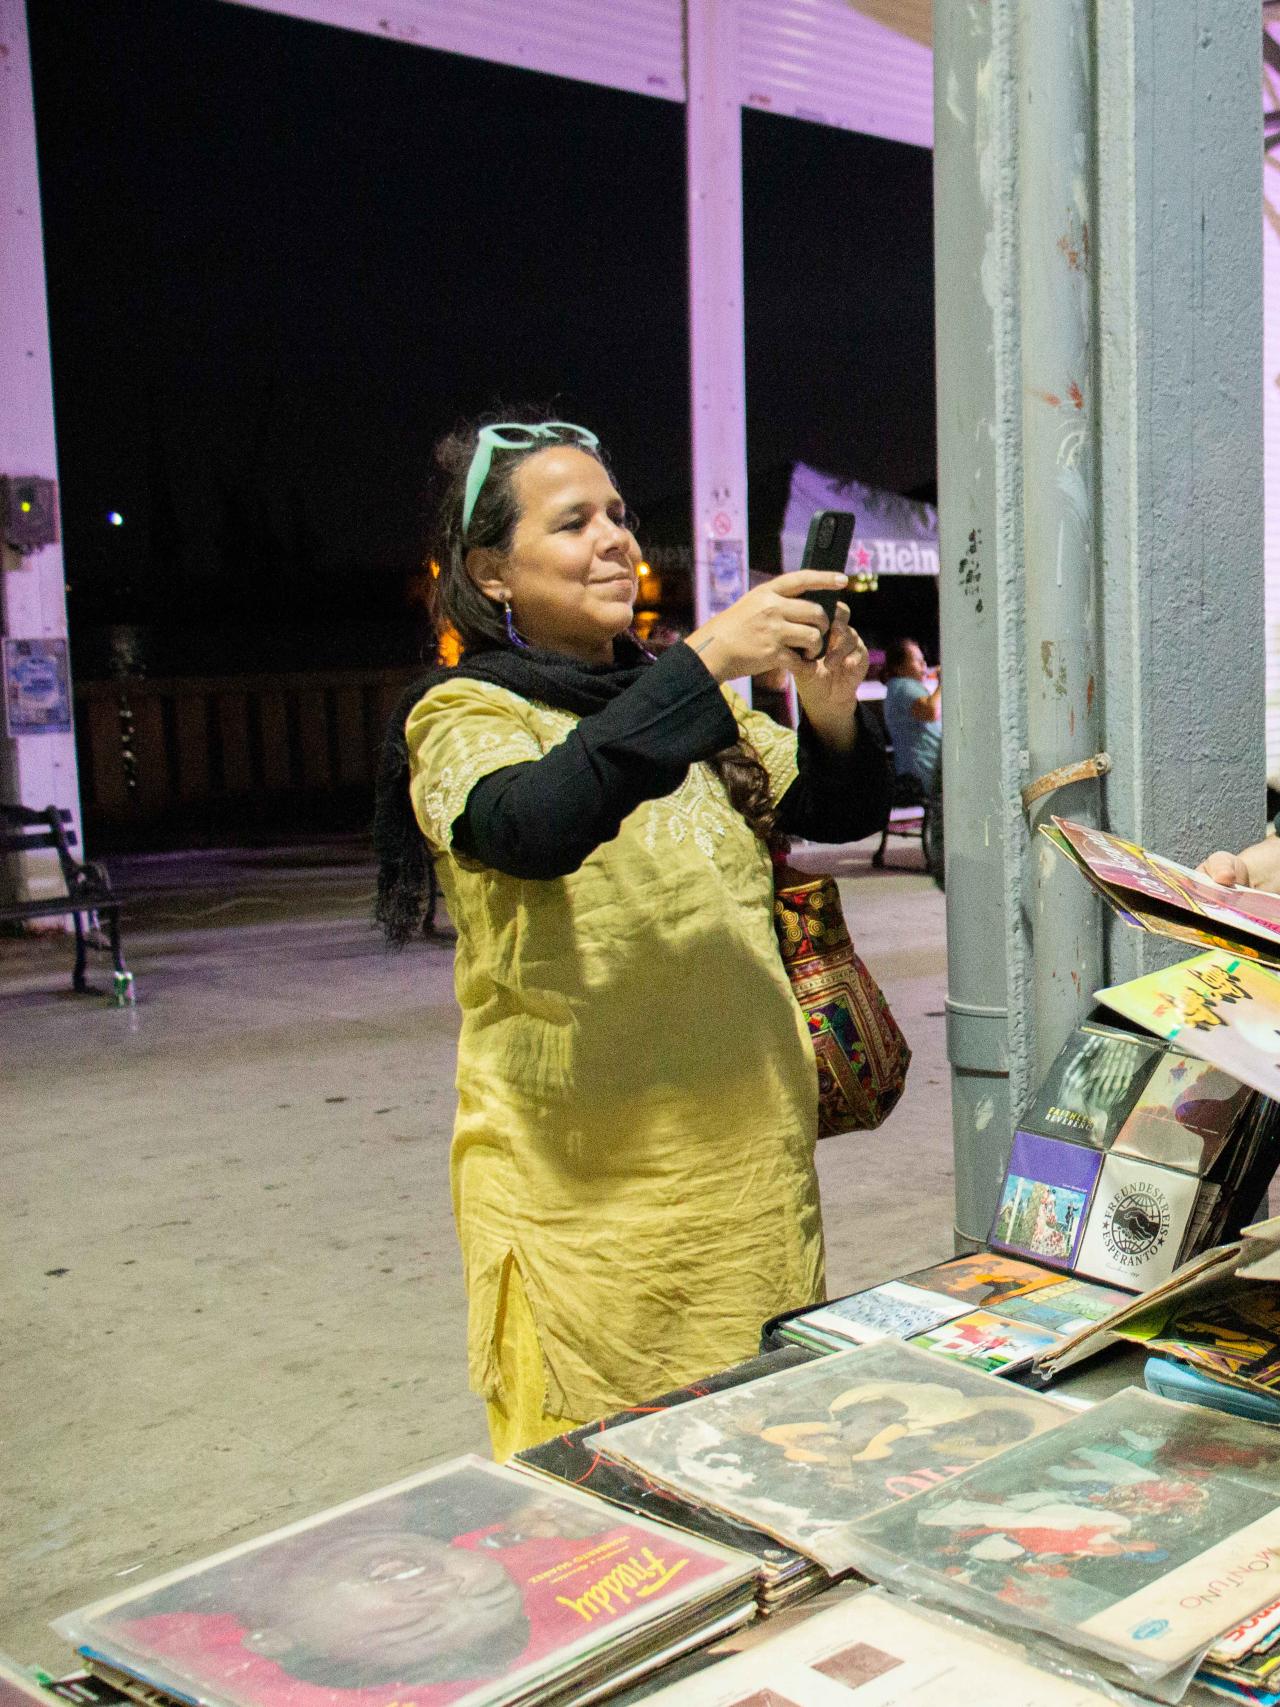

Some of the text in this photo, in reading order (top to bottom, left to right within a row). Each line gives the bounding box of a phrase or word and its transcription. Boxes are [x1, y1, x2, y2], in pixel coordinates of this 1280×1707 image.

[1045, 1113, 1094, 1131] REVERENC
[1048, 1106, 1094, 1125] FAITHLES
[1104, 1181, 1171, 1237] FREUNDESKREIS
[1102, 1231, 1159, 1267] ESPERANTO
[555, 1546, 690, 1622] Freddy
[1179, 1546, 1279, 1610] MONTUNO
